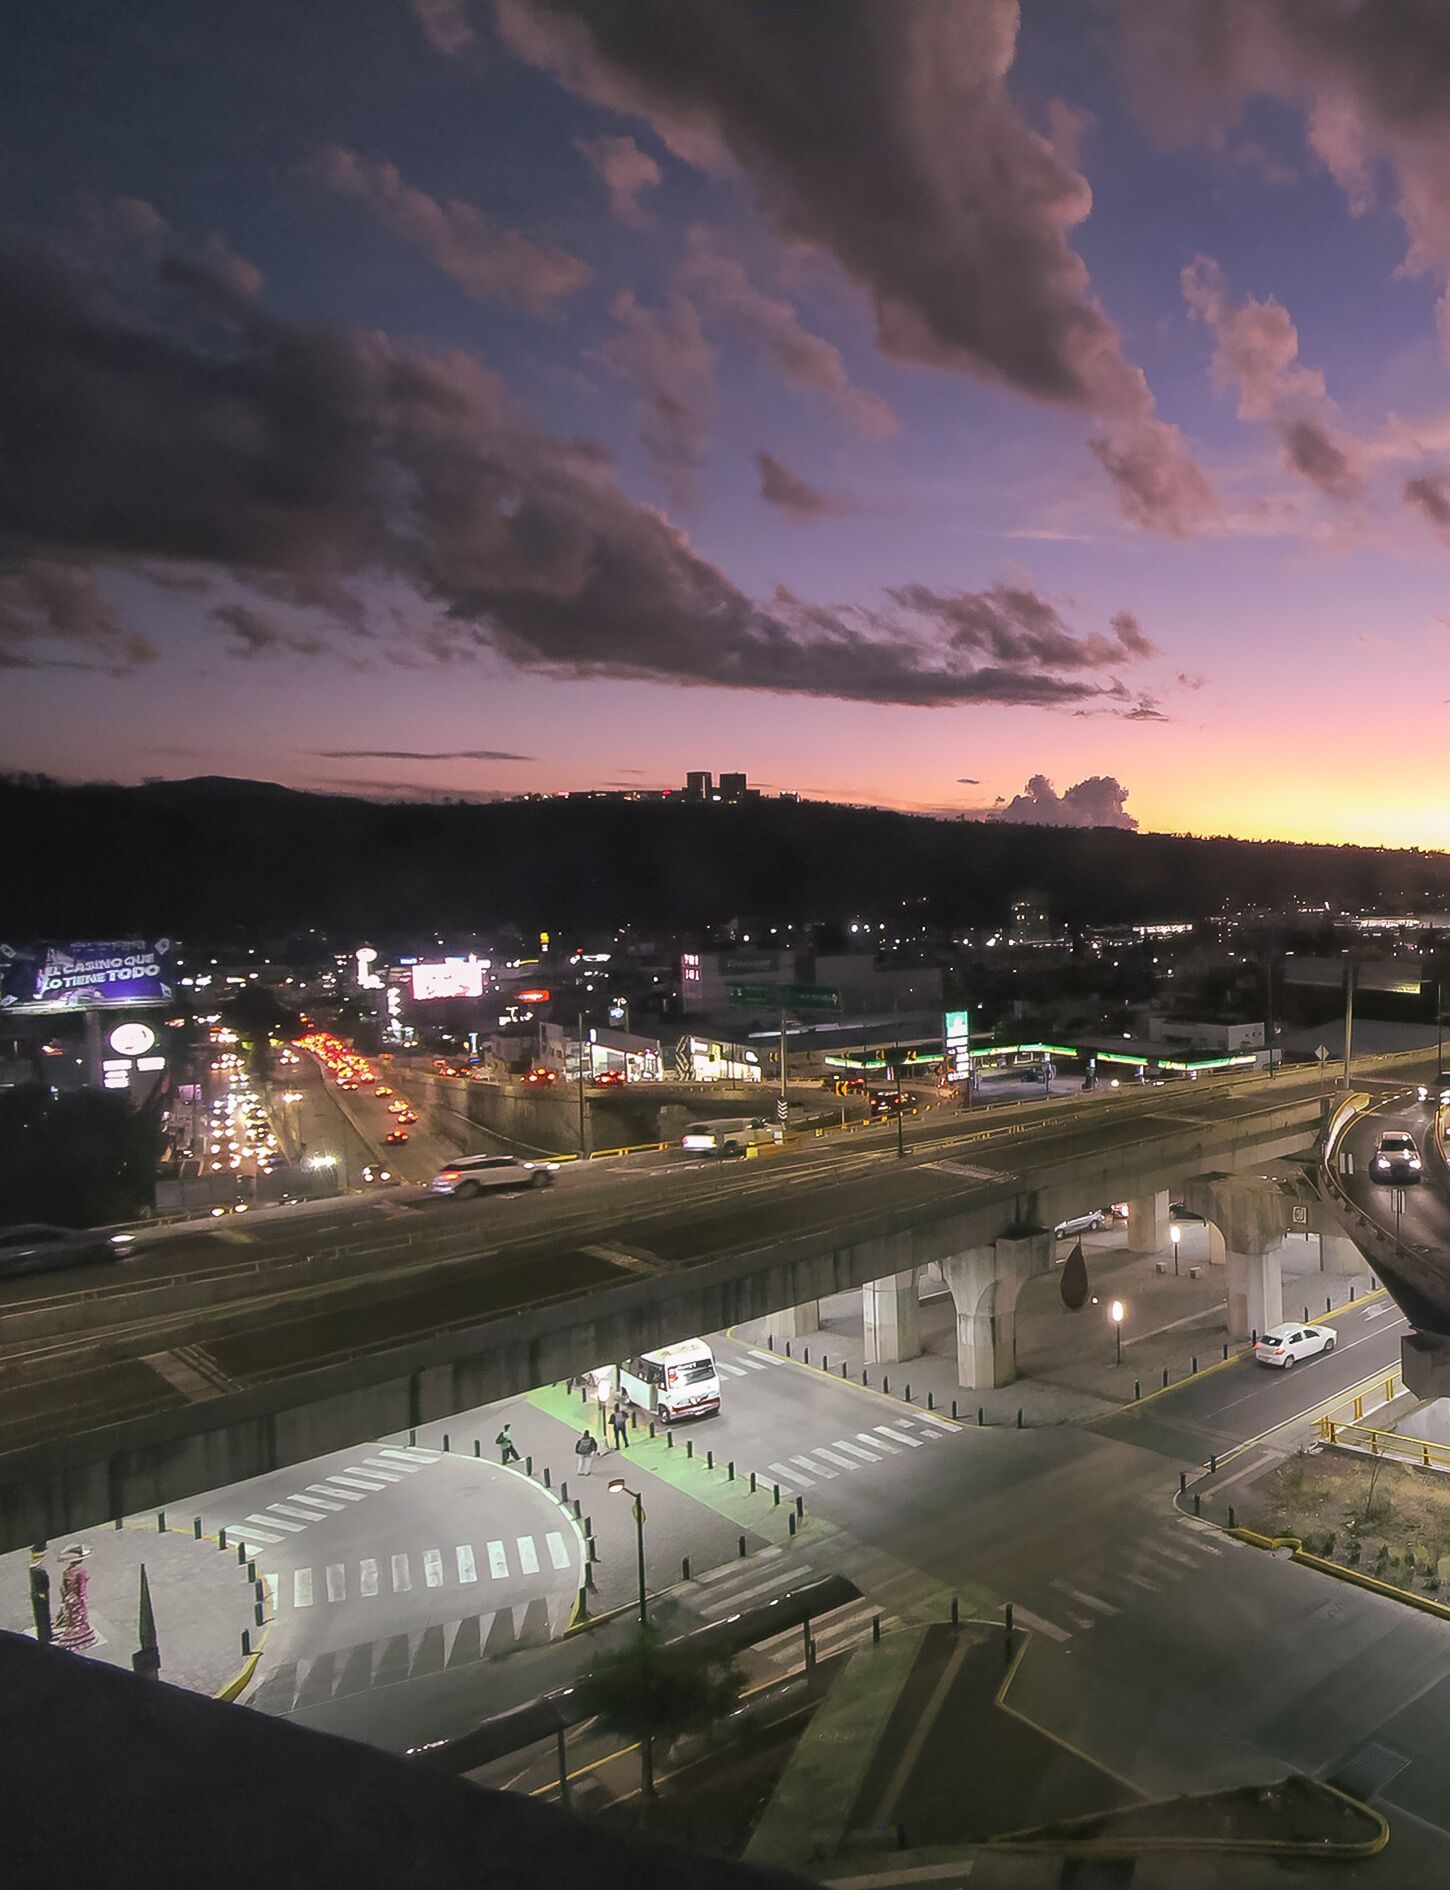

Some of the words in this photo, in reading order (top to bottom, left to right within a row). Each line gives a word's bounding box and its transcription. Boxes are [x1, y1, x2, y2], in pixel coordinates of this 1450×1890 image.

[63, 958, 123, 974] CASINO
[124, 953, 155, 966] QUE
[63, 971, 106, 987] TIENE
[107, 964, 161, 982] TODO
